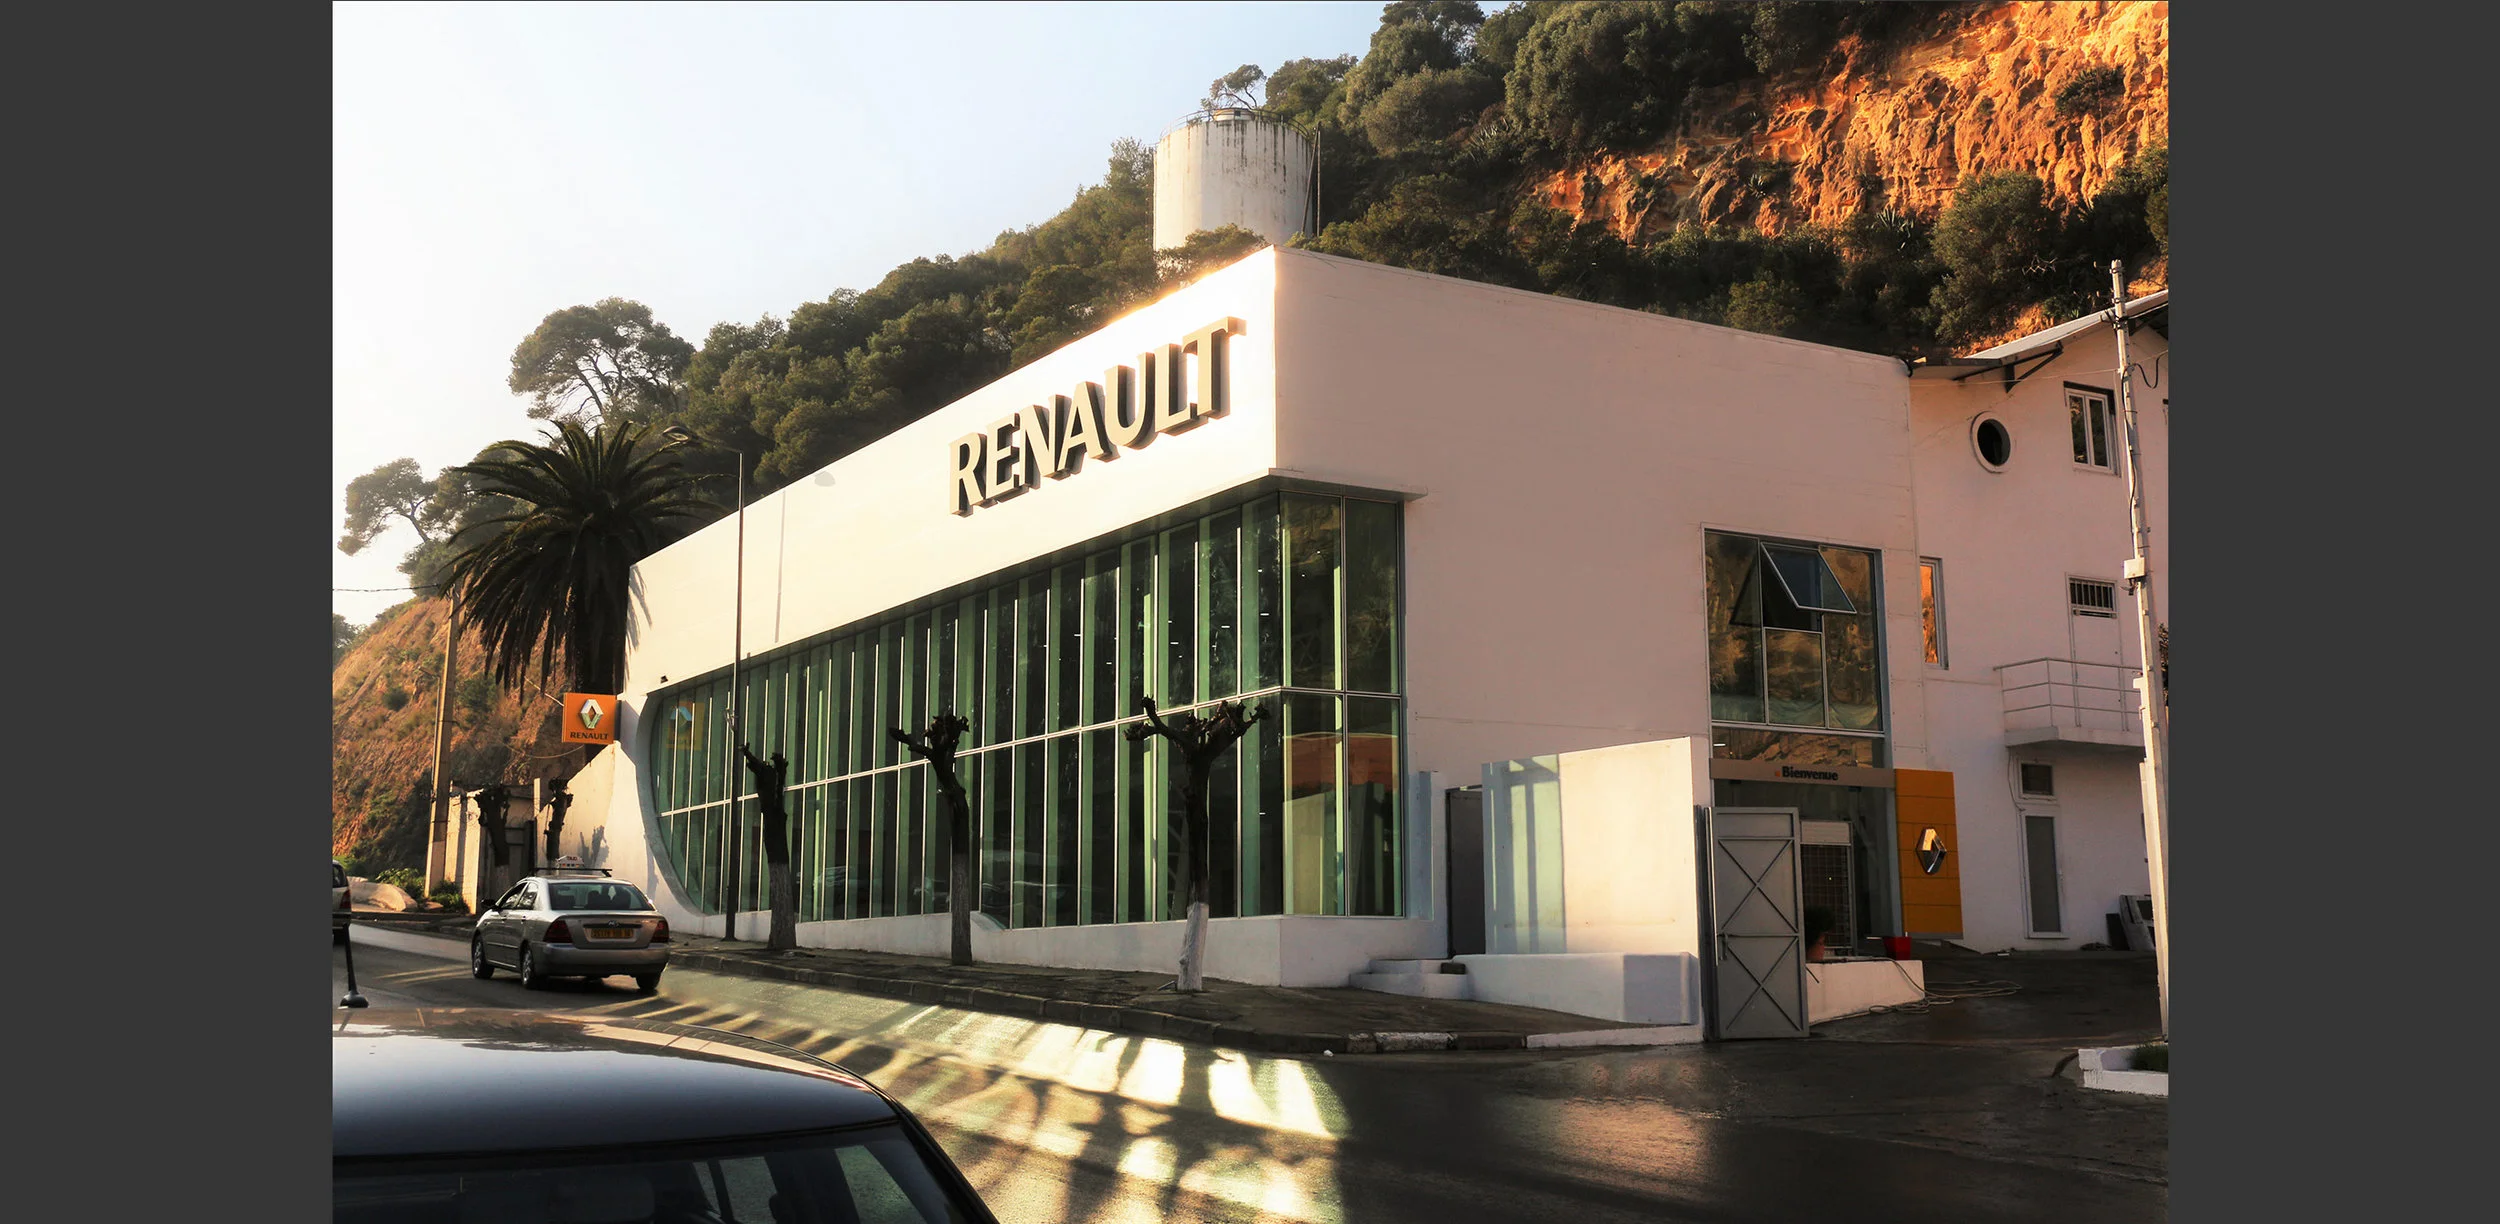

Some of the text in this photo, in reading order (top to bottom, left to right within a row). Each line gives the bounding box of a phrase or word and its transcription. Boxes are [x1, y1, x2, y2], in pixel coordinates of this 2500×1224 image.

[949, 315, 1246, 518] RENAULT
[569, 731, 608, 740] RENAULT
[1782, 766, 1839, 781] Bienvenue
